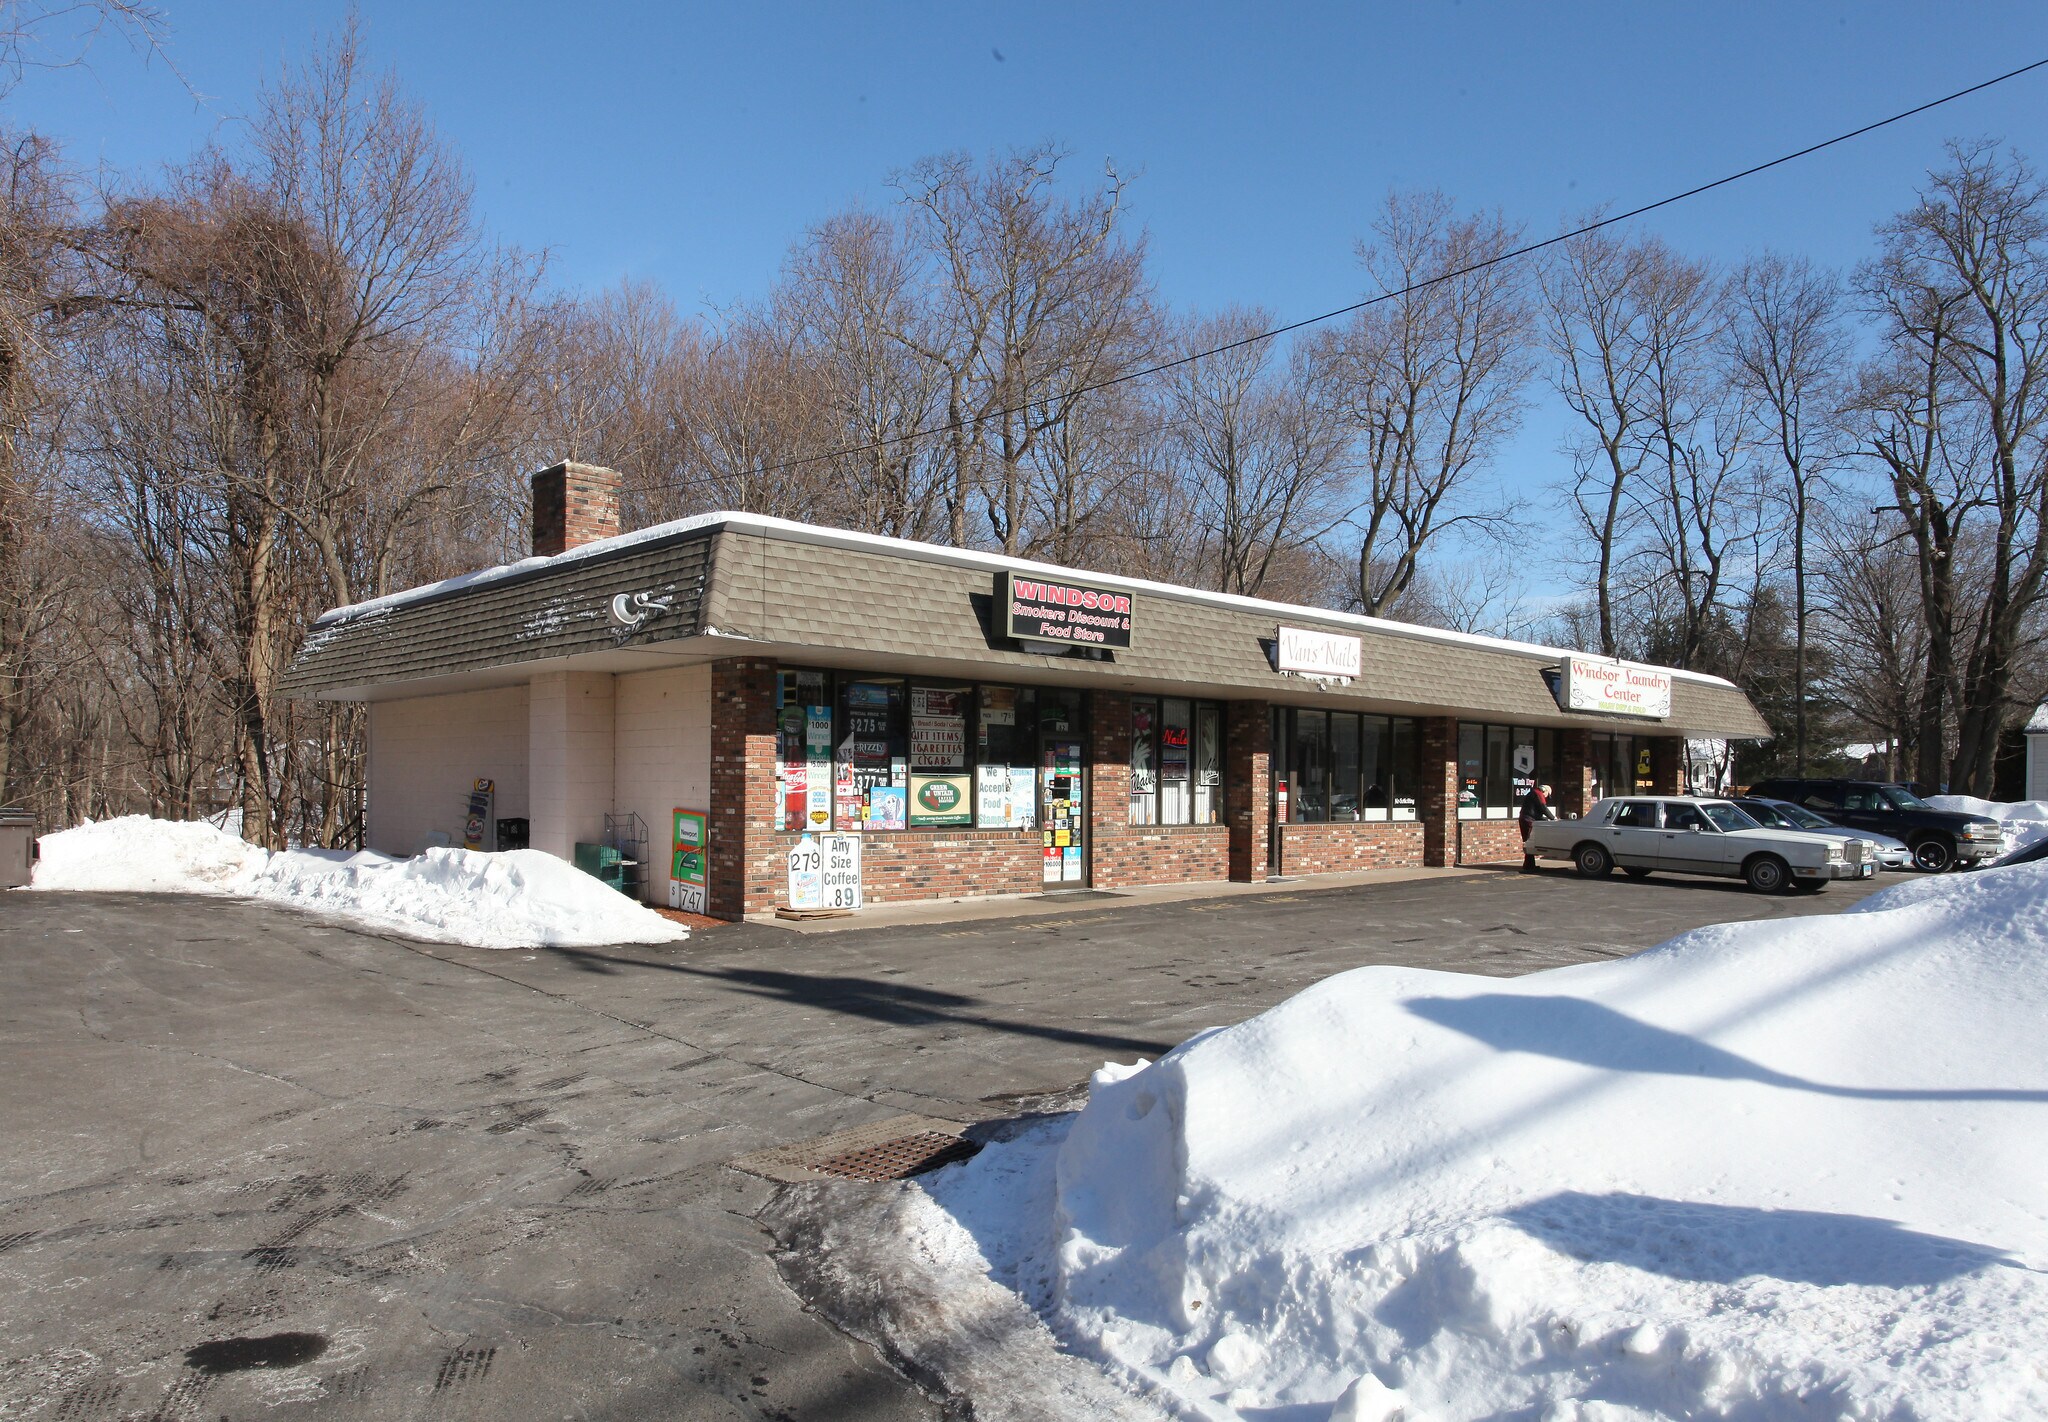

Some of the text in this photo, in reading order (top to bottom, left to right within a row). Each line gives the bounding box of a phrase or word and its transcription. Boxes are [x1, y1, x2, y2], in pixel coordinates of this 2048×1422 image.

[1013, 580, 1131, 614] WINDSOR
[1012, 601, 1130, 630] Smokers Discount &
[1040, 622, 1105, 642] Food Store
[1282, 635, 1358, 668] Van's Nails
[1572, 660, 1669, 692] Windsor Laundry
[1604, 684, 1642, 703] Center
[932, 731, 959, 742] ITEMS
[1163, 729, 1188, 745] Nails
[912, 743, 963, 754] IGARETTES
[917, 755, 951, 766] CIGARS
[986, 767, 997, 777] We
[1131, 769, 1157, 791] Nails
[979, 782, 1005, 794] Accept
[983, 798, 1001, 808] Food
[978, 814, 1006, 826] Stamps
[1021, 816, 1035, 828] 279
[831, 839, 850, 855] Any
[790, 852, 820, 872] 279
[831, 856, 851, 868] Size
[824, 872, 858, 885] Coffee
[671, 886, 675, 896] $
